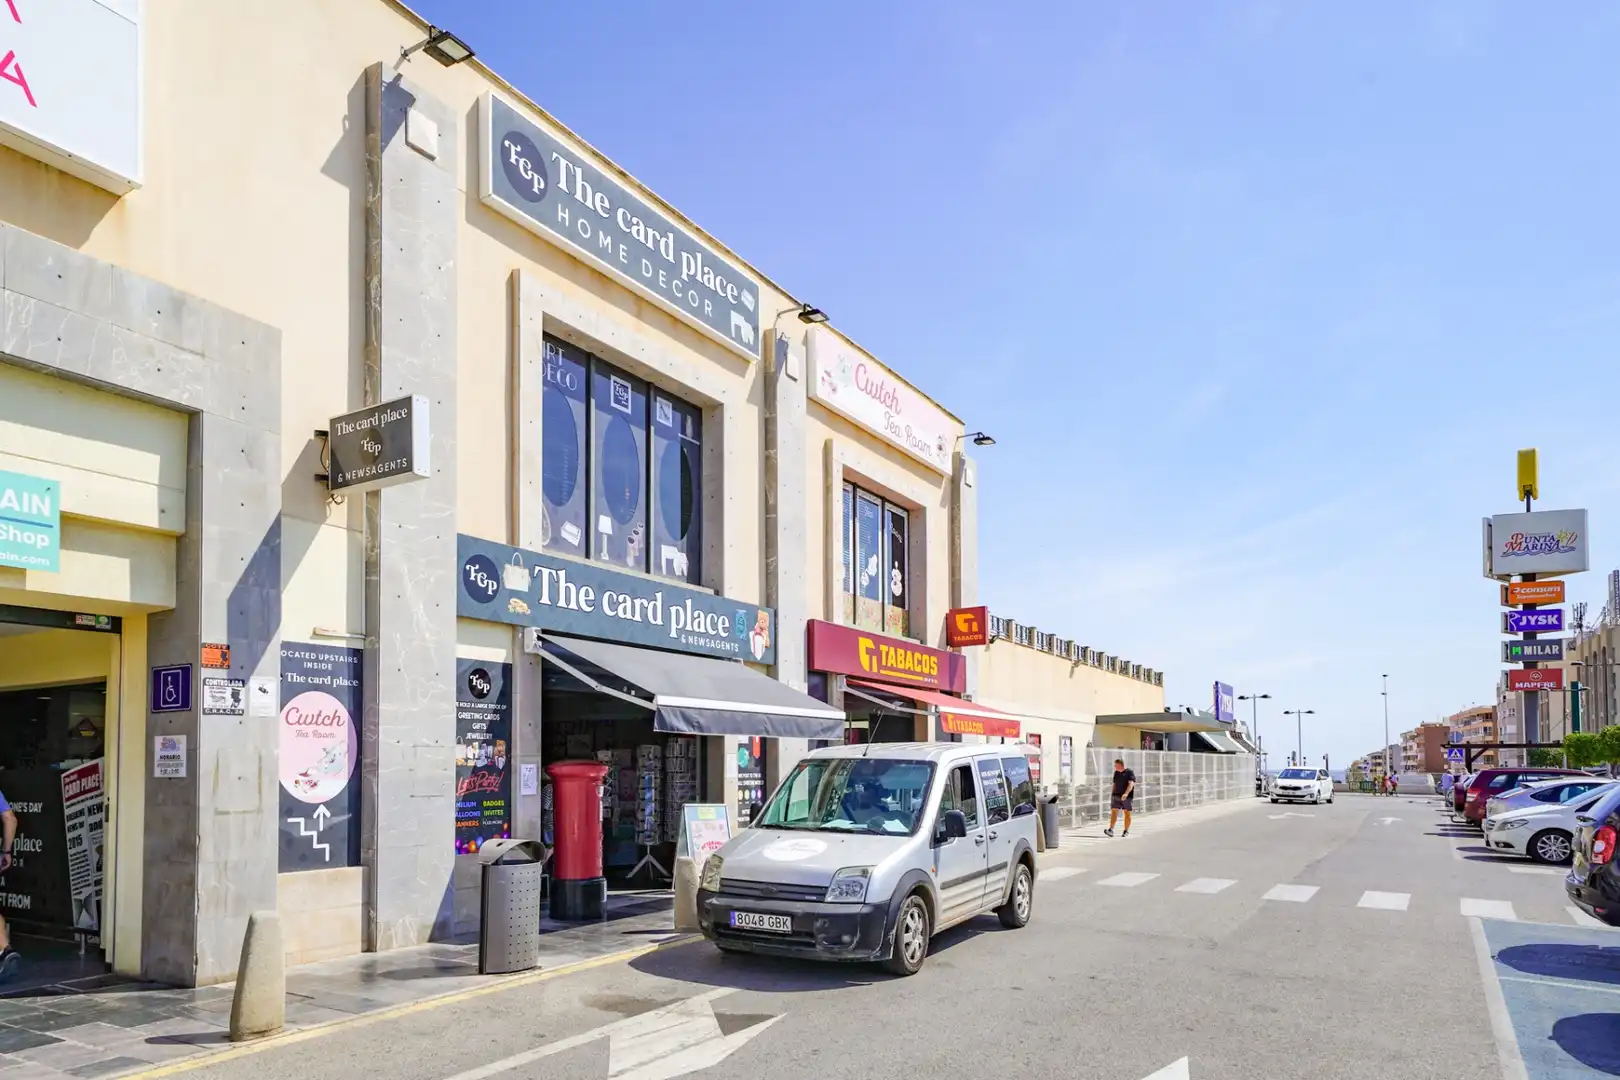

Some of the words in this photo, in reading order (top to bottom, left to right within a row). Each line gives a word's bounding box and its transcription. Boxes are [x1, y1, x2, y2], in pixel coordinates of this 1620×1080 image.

[552, 151, 611, 218] The
[616, 207, 675, 263] card
[680, 250, 738, 304] place
[557, 203, 628, 264] HOME
[641, 258, 712, 317] DECOR
[855, 363, 901, 415] Cwtch
[336, 421, 355, 436] The
[356, 412, 378, 430] card
[380, 407, 408, 427] place
[884, 411, 902, 438] Tea
[904, 424, 932, 457] Room
[337, 473, 343, 483] &
[345, 458, 407, 481] NEWSAGENTS
[0, 488, 50, 518] AIN
[0, 524, 50, 549] Shop
[1511, 532, 1555, 545] PUNTA
[1503, 539, 1560, 555] MARINA
[533, 565, 596, 613] The
[601, 591, 664, 627] card
[668, 604, 730, 639] place
[1519, 614, 1560, 626] JYSK
[681, 634, 686, 643] &
[688, 635, 739, 652] NEWSAGENTS
[952, 634, 983, 642] TABACOS
[318, 653, 358, 664] UPSTAIRS
[1523, 644, 1560, 656] MILAR
[303, 661, 333, 671] INSIDE
[879, 643, 938, 676] TABACOS
[285, 672, 306, 683] The
[308, 675, 331, 685] card
[333, 676, 359, 688] place
[1515, 681, 1557, 689] MAPFRE
[285, 706, 345, 726] Cwtch
[457, 711, 483, 720] GREETING
[483, 713, 501, 721] CARDS
[295, 729, 309, 738] Tea
[312, 729, 336, 739] Room
[472, 722, 487, 730] GIFTS
[465, 732, 493, 740] JEWELLERY
[64, 780, 80, 798] CARD
[81, 773, 100, 791] PLACE
[28, 801, 43, 813] DAY
[13, 832, 43, 856] place
[7, 893, 31, 910] FROM
[736, 913, 765, 927] 8048
[767, 916, 789, 930] GBK
